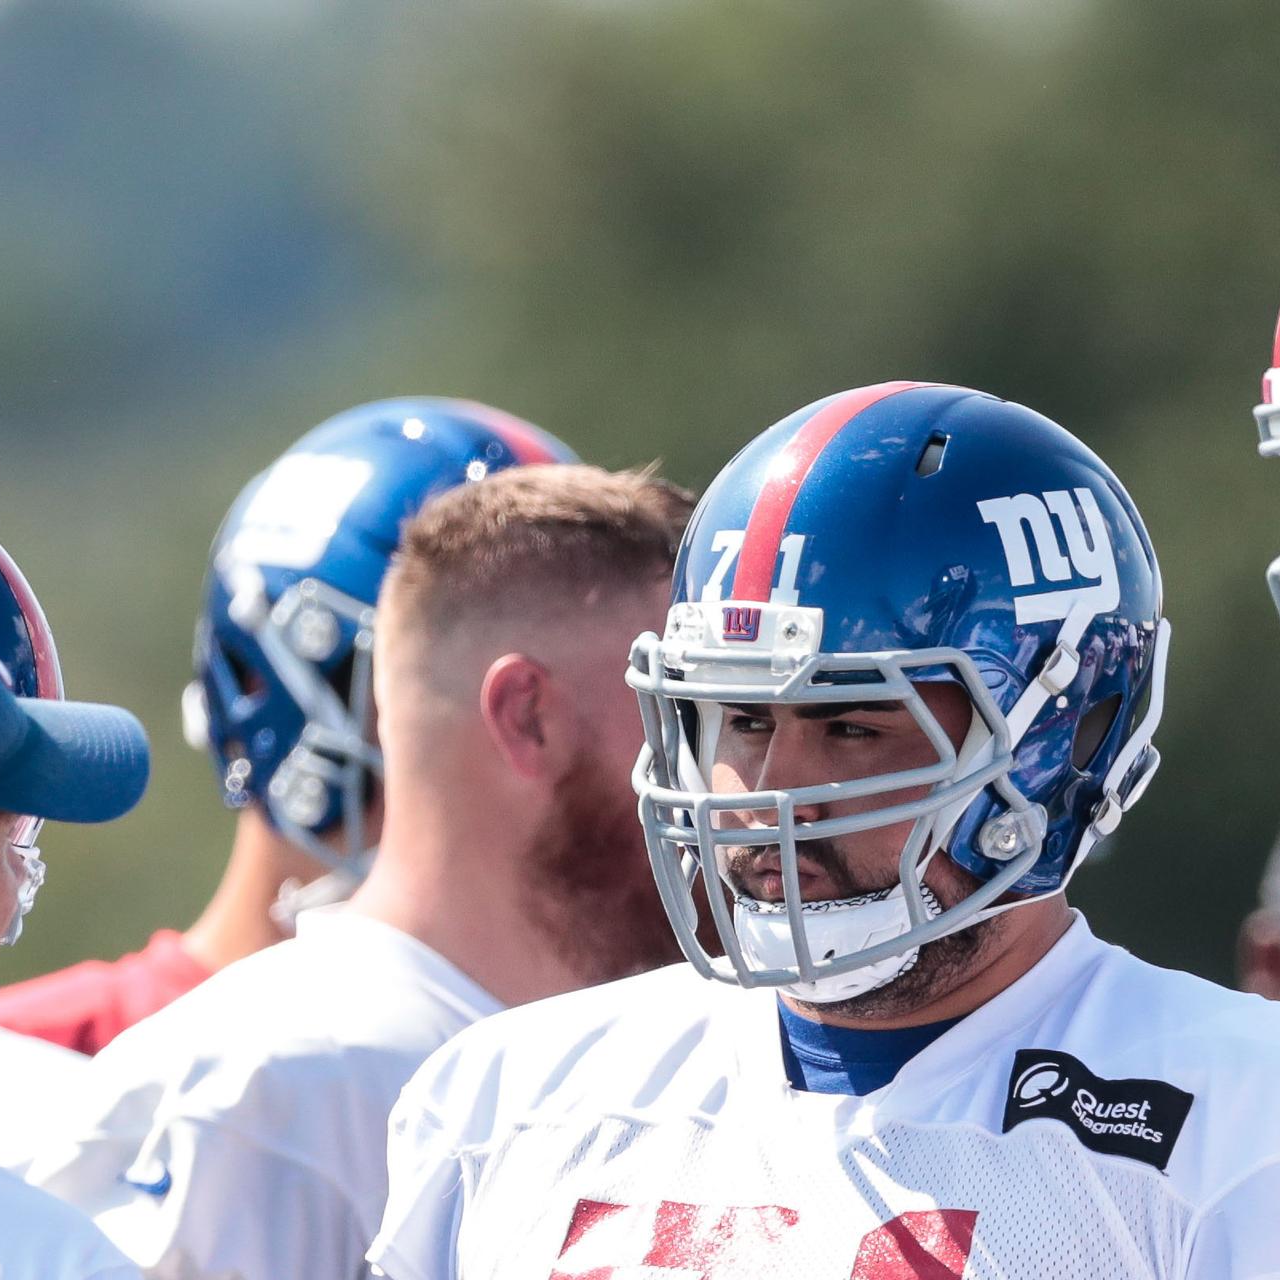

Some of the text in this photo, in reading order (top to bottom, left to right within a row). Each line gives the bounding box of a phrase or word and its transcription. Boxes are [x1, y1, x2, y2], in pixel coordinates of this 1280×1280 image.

[701, 529, 806, 607] 71
[1071, 1100, 1164, 1144] Diagnostics
[1076, 1088, 1152, 1121] Quest
